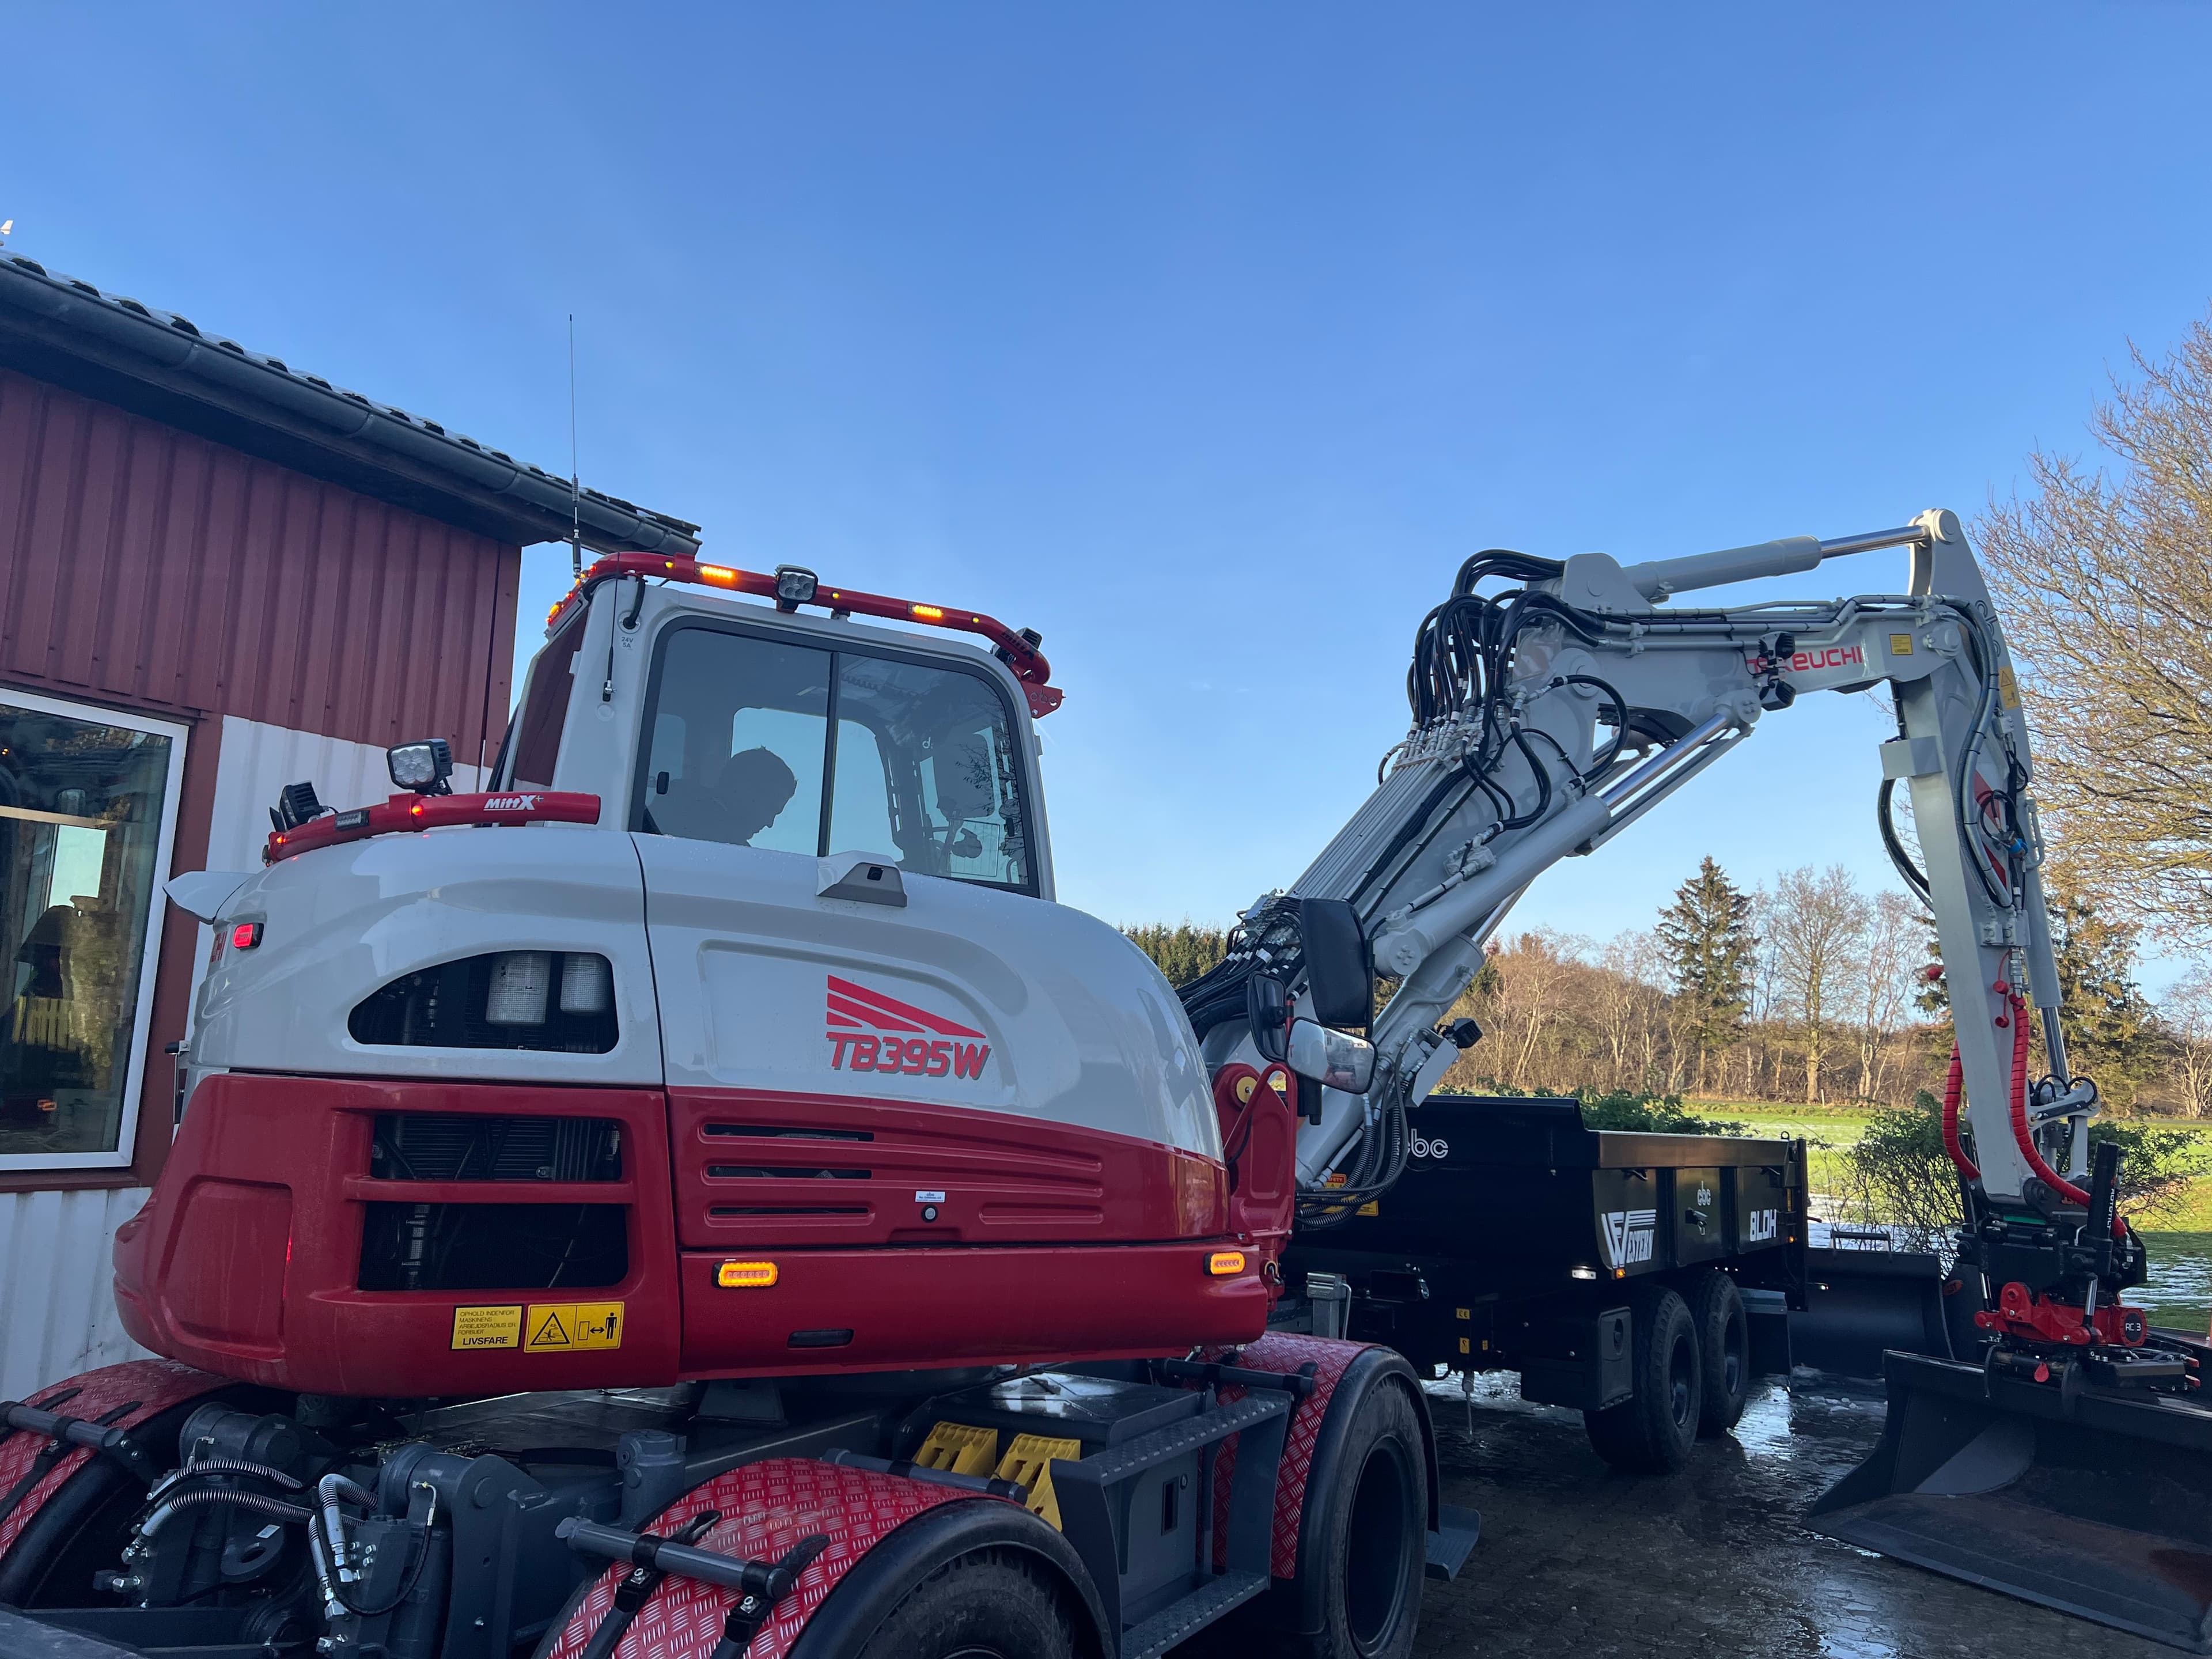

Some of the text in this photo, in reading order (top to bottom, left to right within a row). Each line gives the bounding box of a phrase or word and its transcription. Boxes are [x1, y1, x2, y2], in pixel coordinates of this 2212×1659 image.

[1746, 646, 1862, 673] TEUCHI
[826, 1031, 991, 1081] TB395W
[1408, 1128, 1449, 1159] bc
[2125, 1323, 2141, 1331] RC 3
[463, 1336, 509, 1346] LIVSFARE
